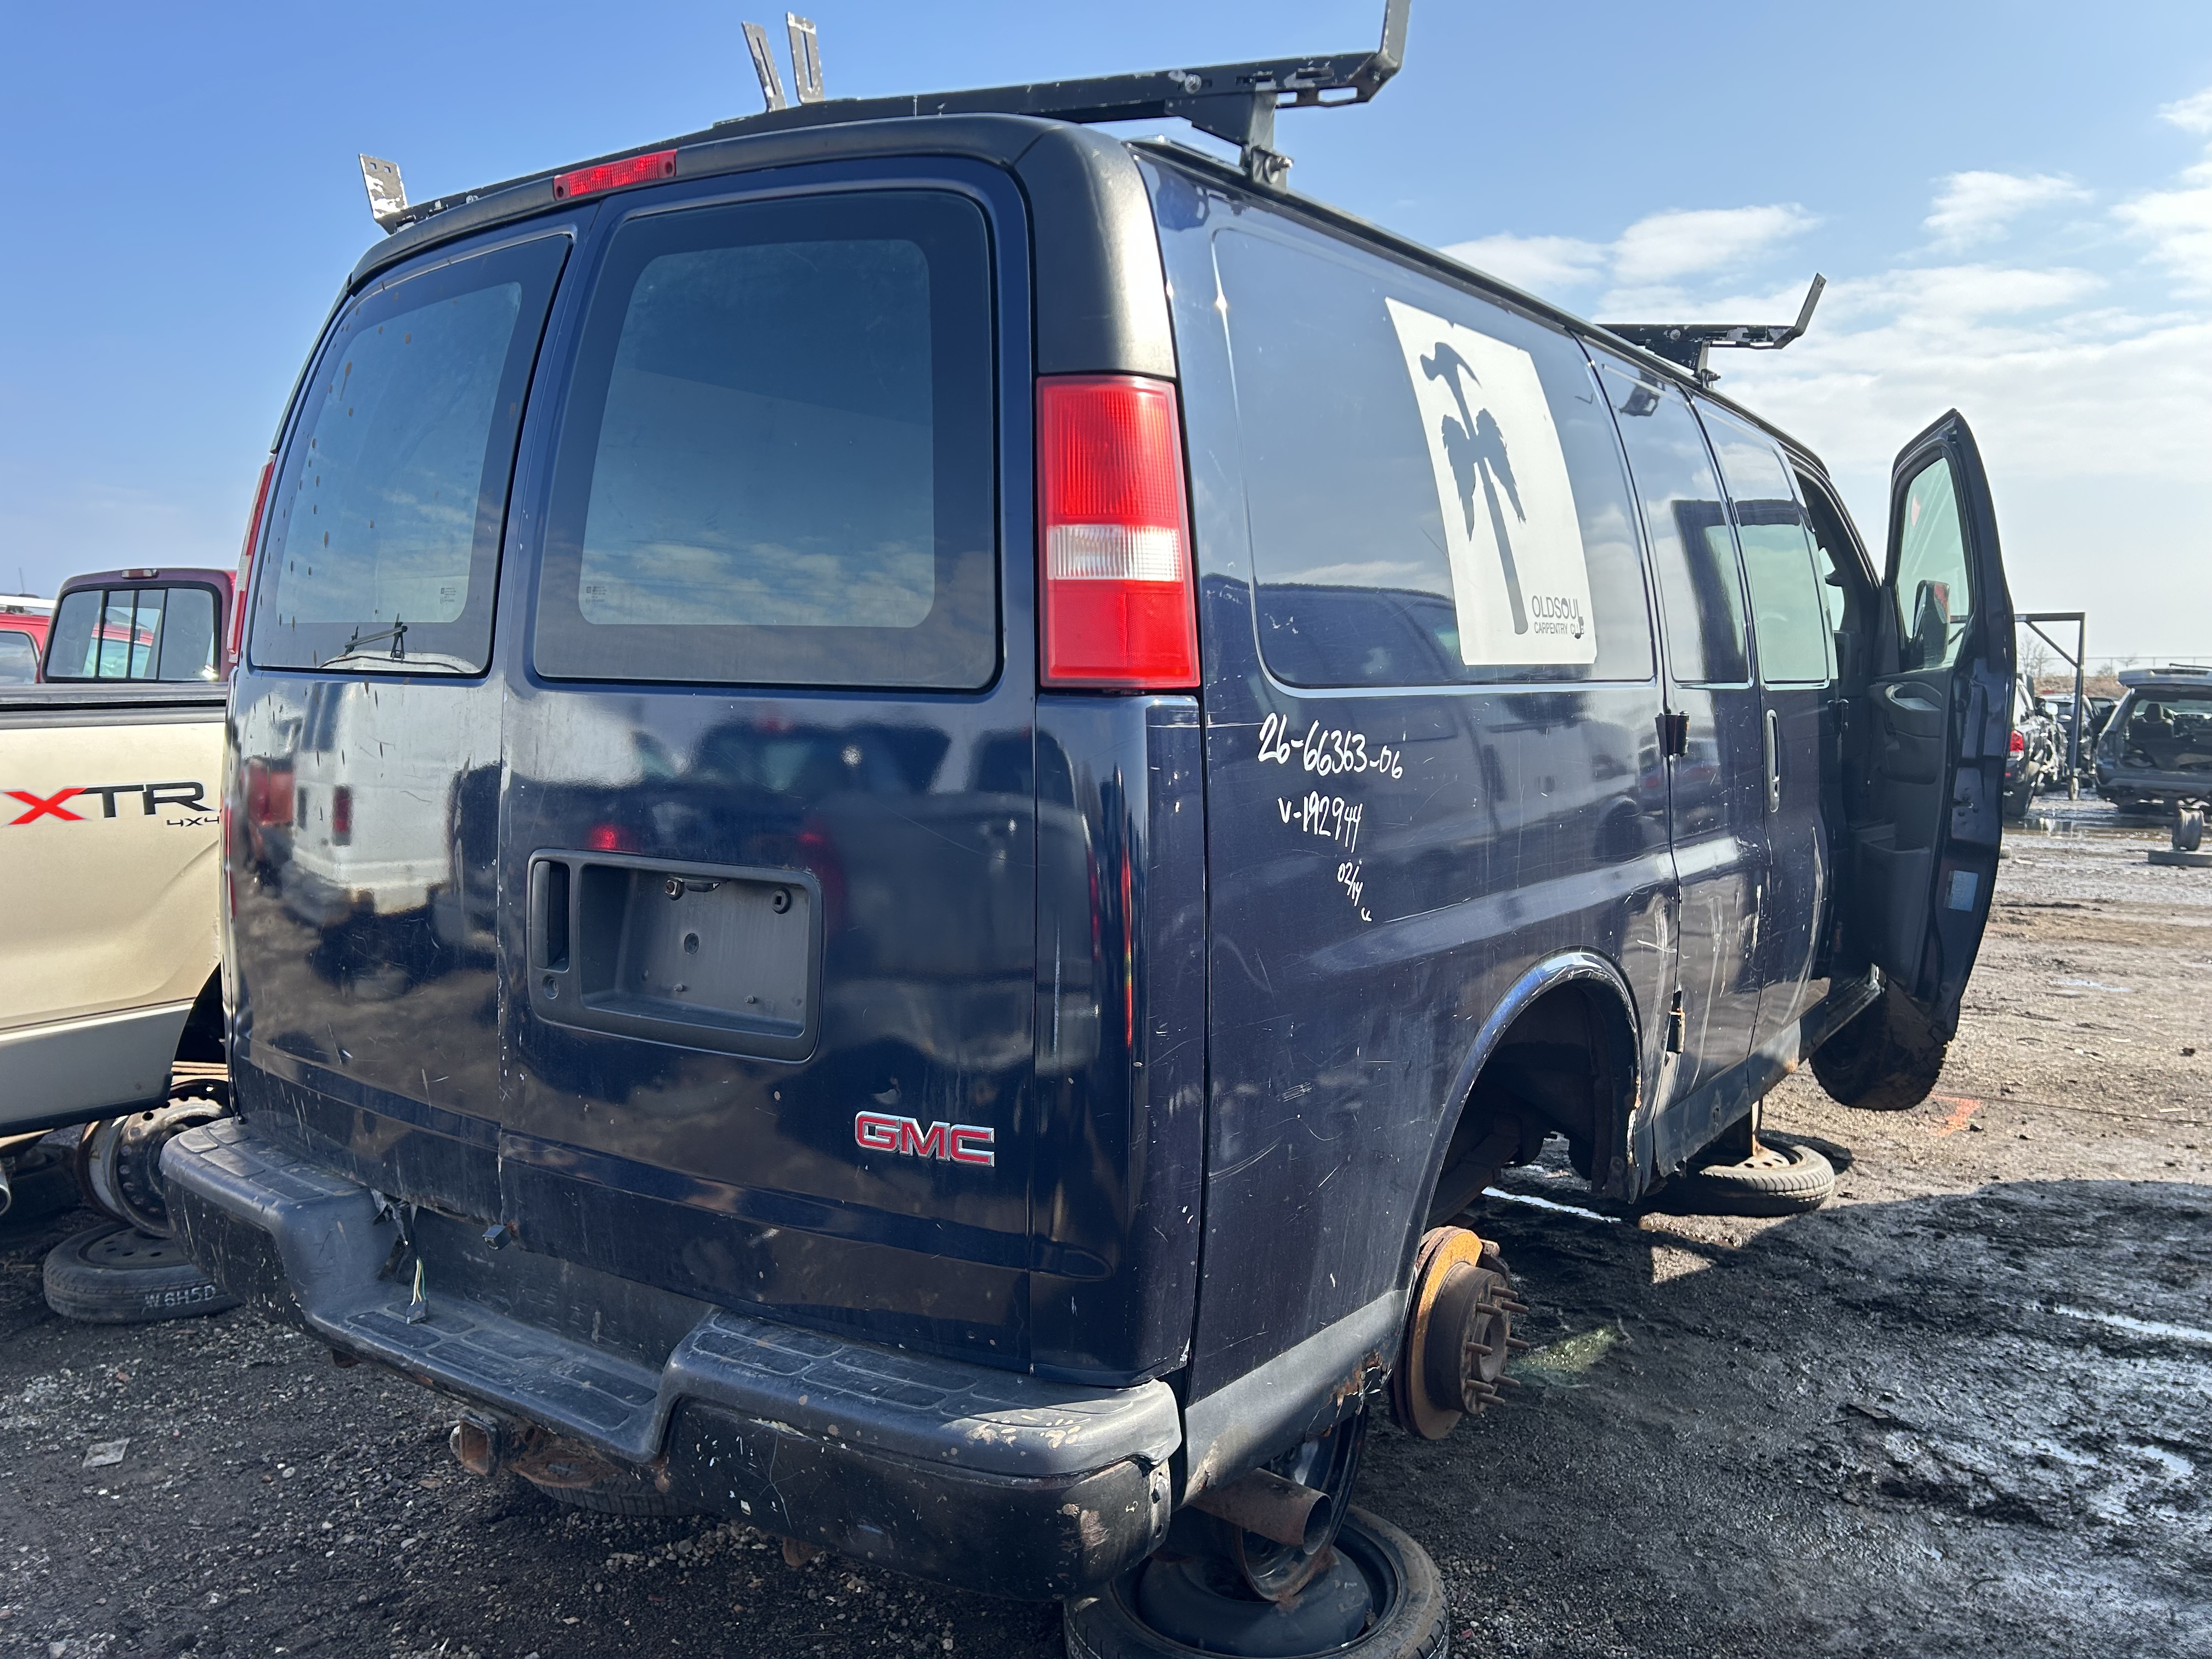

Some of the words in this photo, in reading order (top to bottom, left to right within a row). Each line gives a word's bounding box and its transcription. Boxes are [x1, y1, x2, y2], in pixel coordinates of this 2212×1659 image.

[1532, 595, 1583, 619] OLDSOUL
[1534, 622, 1568, 634] CARPENTRY
[2, 782, 216, 825] XTR
[855, 1110, 995, 1167] GMC
